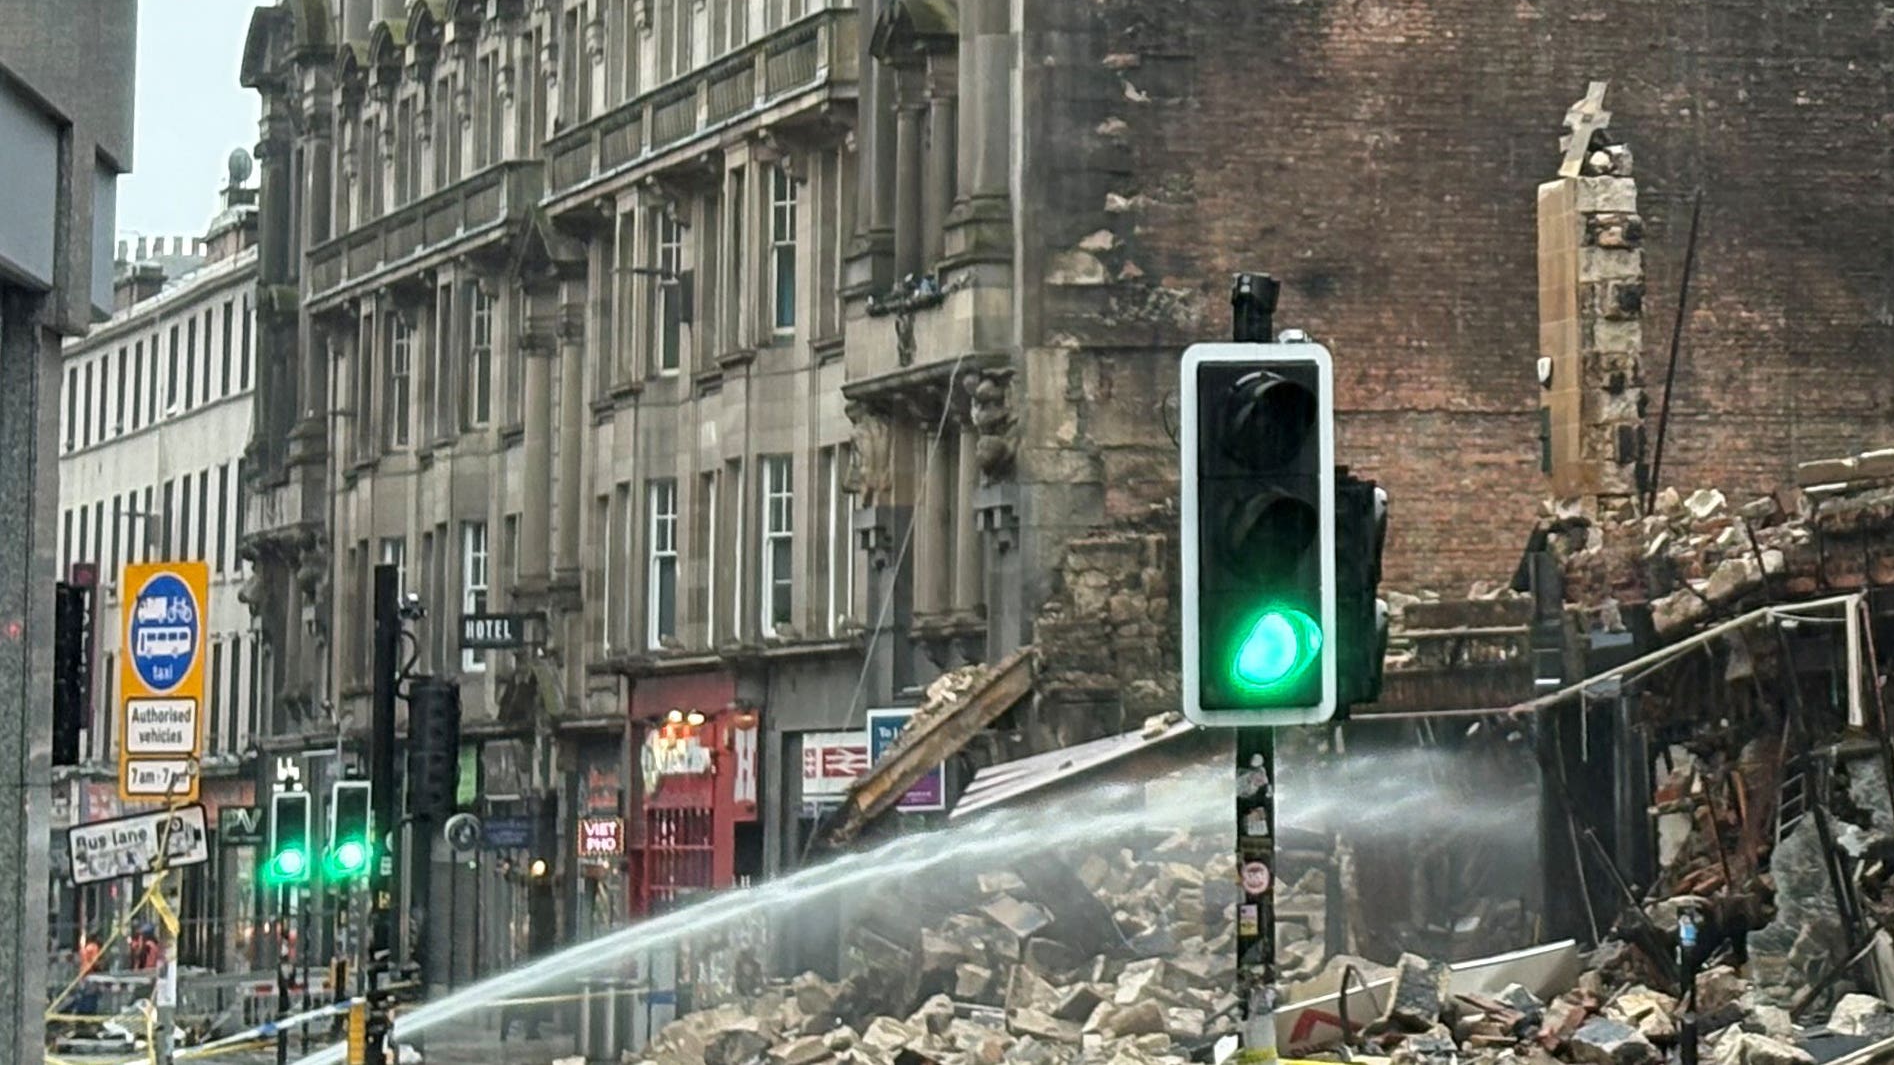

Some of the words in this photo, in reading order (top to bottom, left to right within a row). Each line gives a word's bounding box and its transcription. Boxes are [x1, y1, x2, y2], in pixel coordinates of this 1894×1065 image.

[465, 619, 512, 639] HOTEL
[152, 664, 173, 680] taxi
[131, 706, 192, 725] Authorised
[139, 728, 183, 745] vehicles
[112, 827, 148, 847] lane
